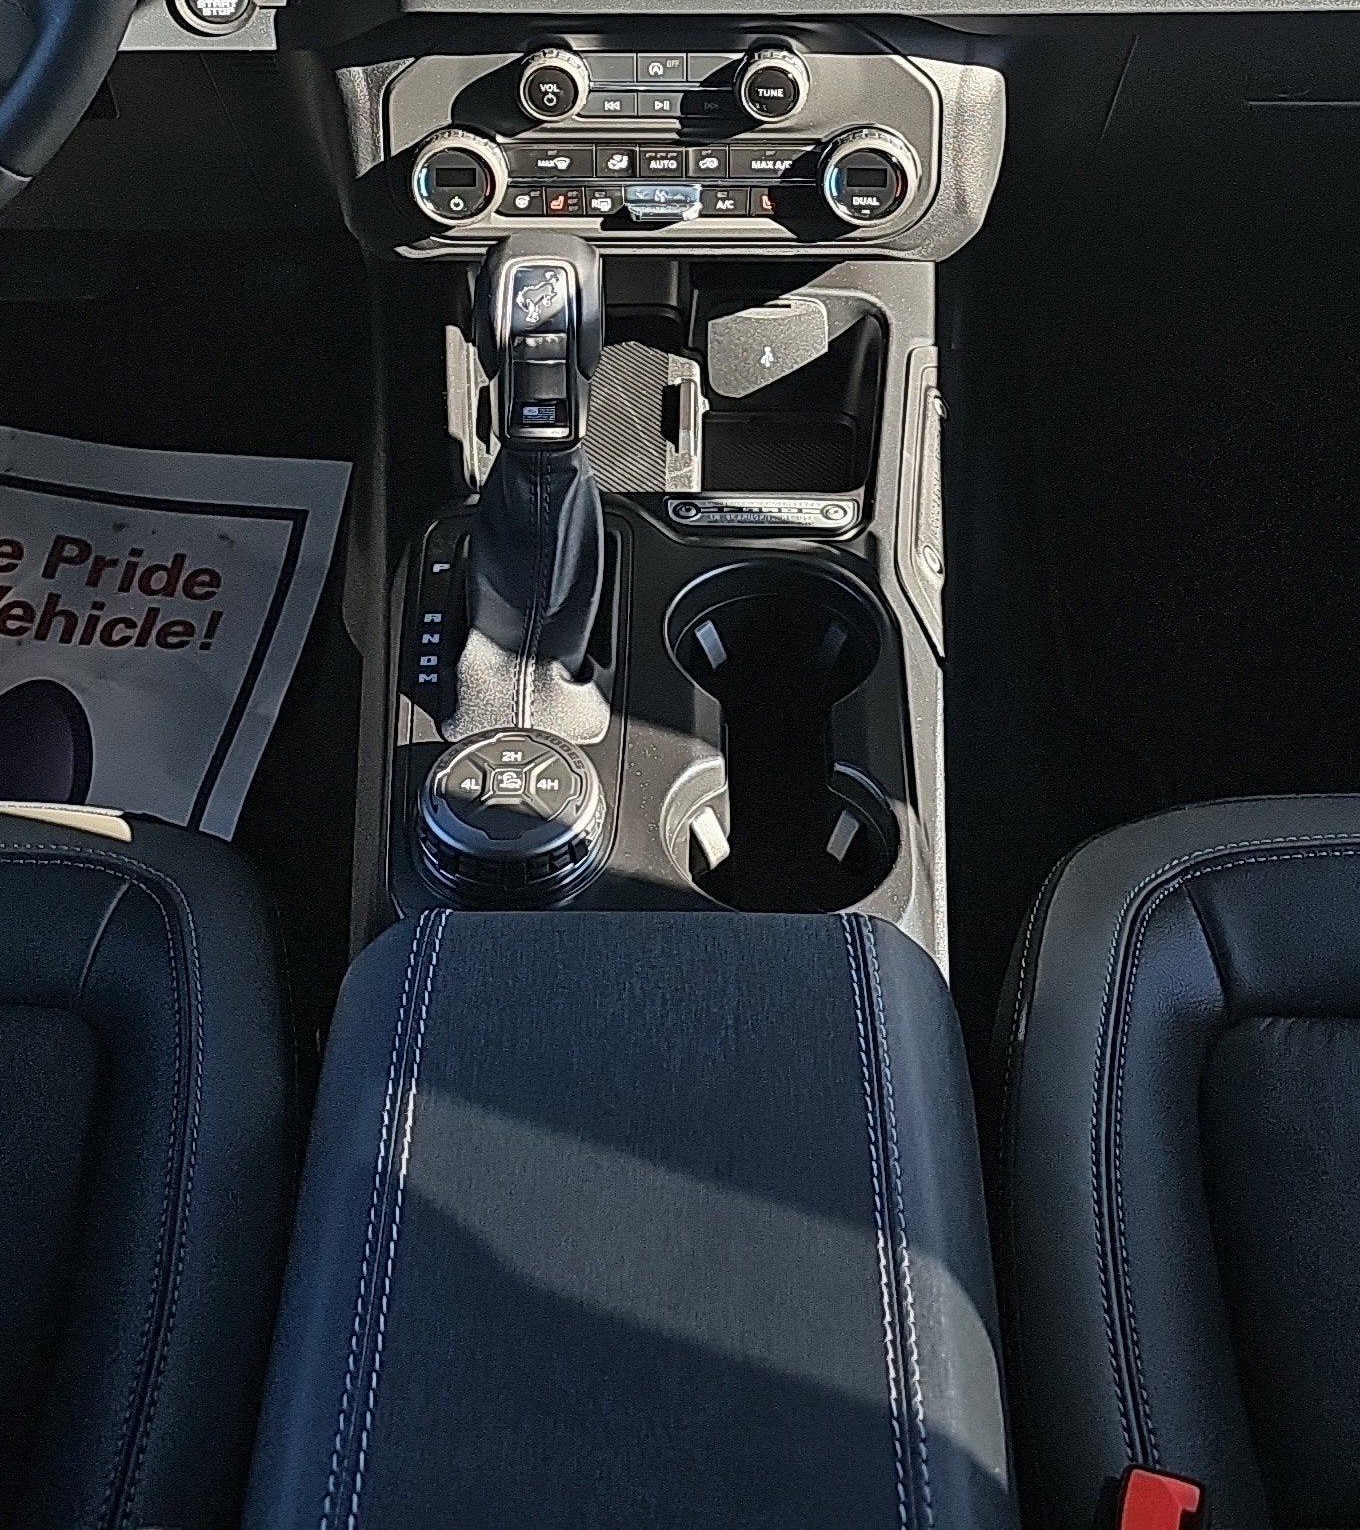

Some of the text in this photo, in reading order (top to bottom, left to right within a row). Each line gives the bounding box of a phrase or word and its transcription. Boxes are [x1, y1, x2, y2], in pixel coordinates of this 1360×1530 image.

[196, 0, 239, 8] START
[202, 7, 236, 16] STOP
[666, 59, 680, 68] OFF
[539, 83, 561, 93] VOL
[757, 88, 784, 98] TUNE
[537, 159, 556, 168] MAX
[649, 160, 678, 169] AUTO
[751, 160, 774, 169] MAX
[716, 199, 735, 210] A/C
[852, 197, 880, 206] DUAL
[40, 533, 223, 601] Pride
[432, 563, 451, 573] P
[423, 613, 443, 623] R
[421, 633, 441, 644] N
[419, 655, 438, 666] D
[418, 673, 438, 683] M
[501, 751, 523, 762] 2H
[460, 778, 481, 790] 4L
[536, 778, 559, 791] 4H
